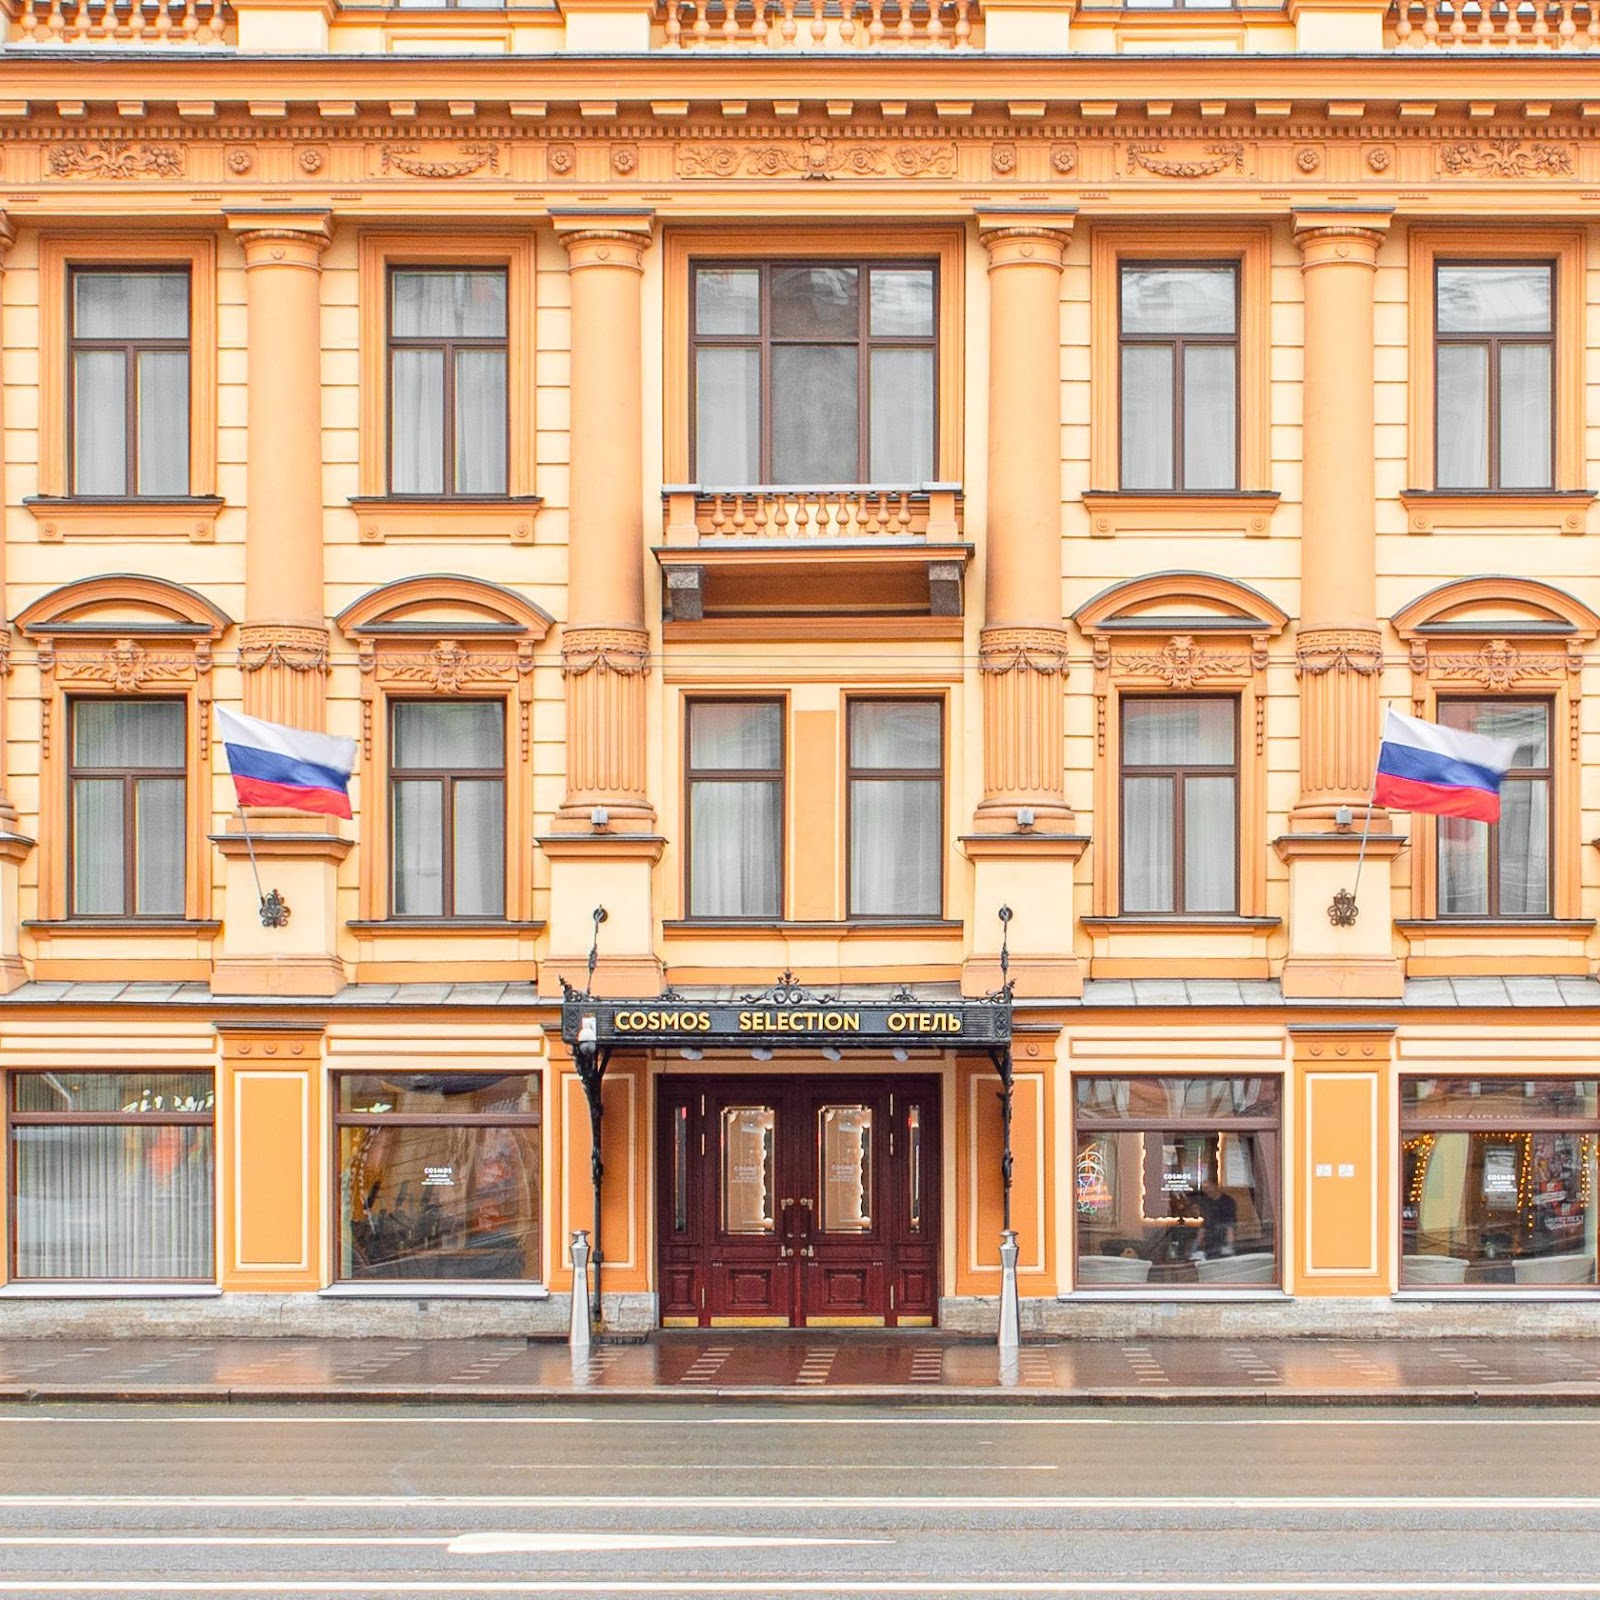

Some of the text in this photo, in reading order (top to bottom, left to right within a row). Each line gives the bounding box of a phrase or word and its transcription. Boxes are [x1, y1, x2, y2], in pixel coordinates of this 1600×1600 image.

[615, 1011, 962, 1032] COSMOS SELECTION ОТЕЛЬ
